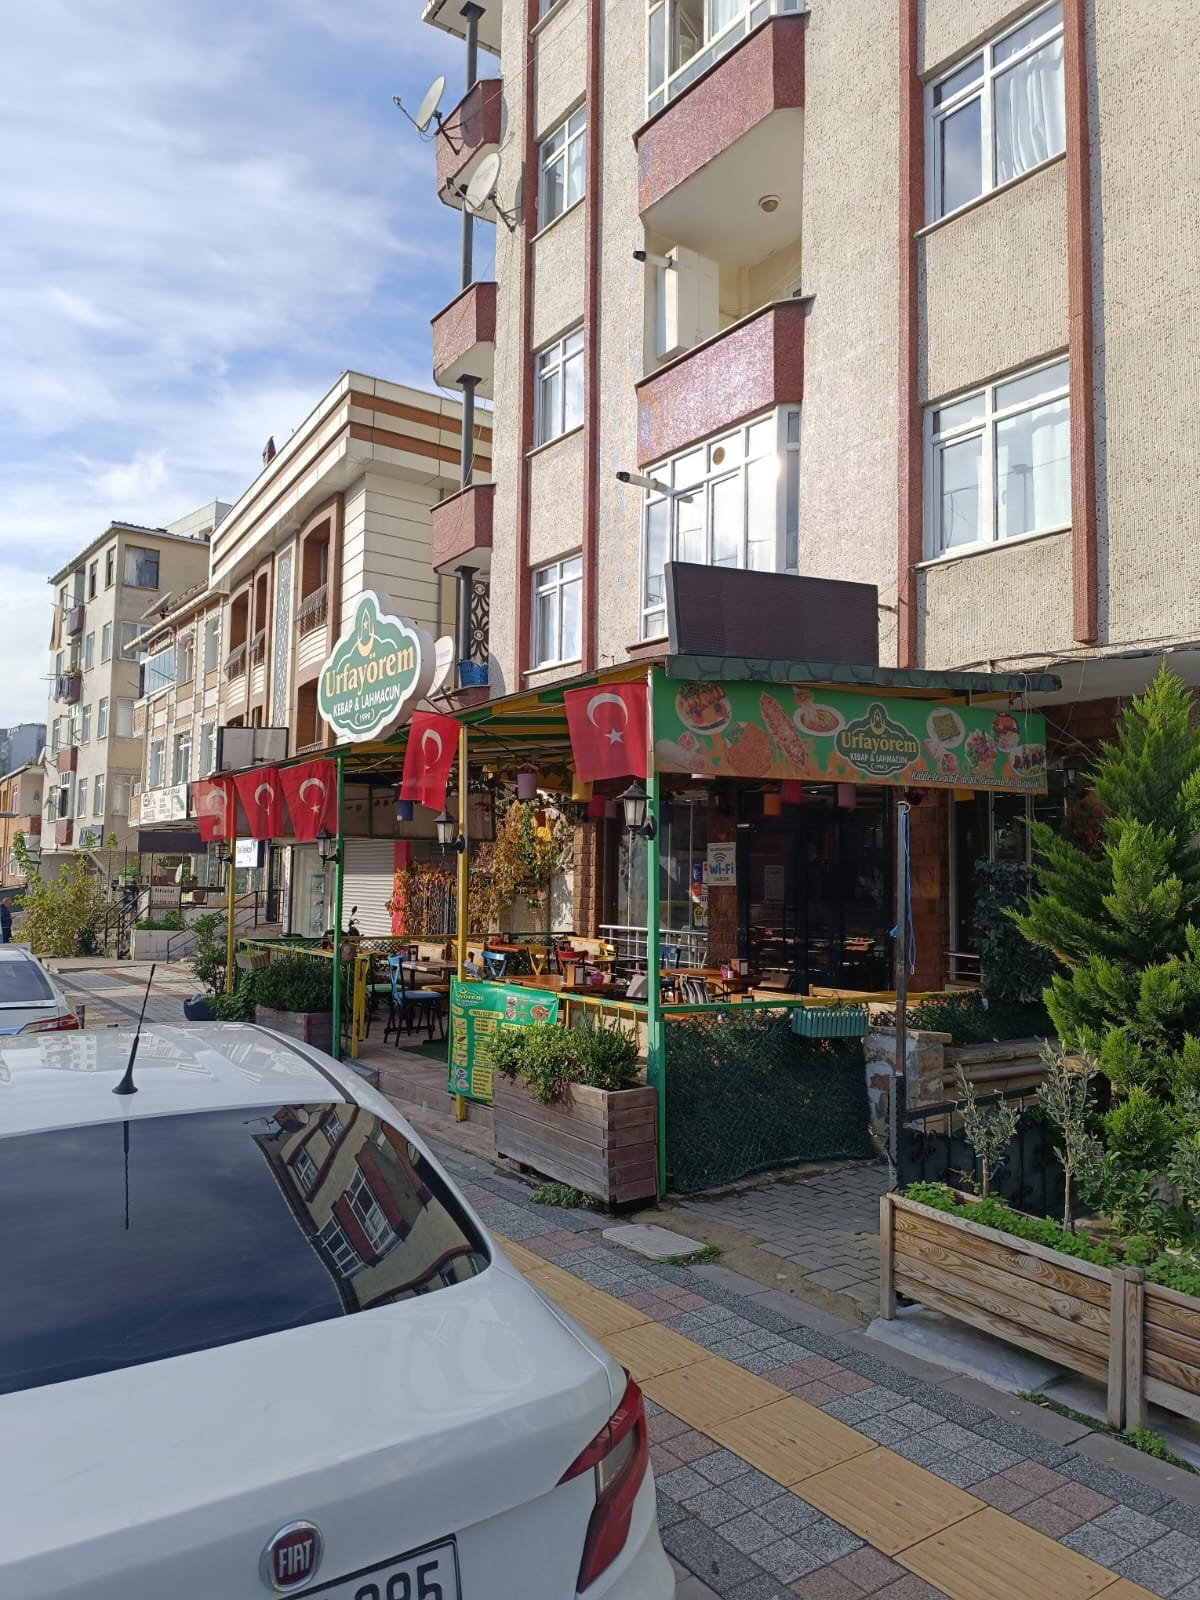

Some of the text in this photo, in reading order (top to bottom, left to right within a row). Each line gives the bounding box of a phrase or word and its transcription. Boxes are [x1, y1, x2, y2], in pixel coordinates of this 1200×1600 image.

[325, 646, 415, 697] Urfayörem
[333, 684, 400, 717] KEBAP & LAHMACUN
[841, 732, 917, 753] Urfayörem
[849, 753, 908, 764] KEBAP & LAHMACUN
[709, 862, 734, 875] Wi-Fi
[279, 1539, 313, 1578] FIAT
